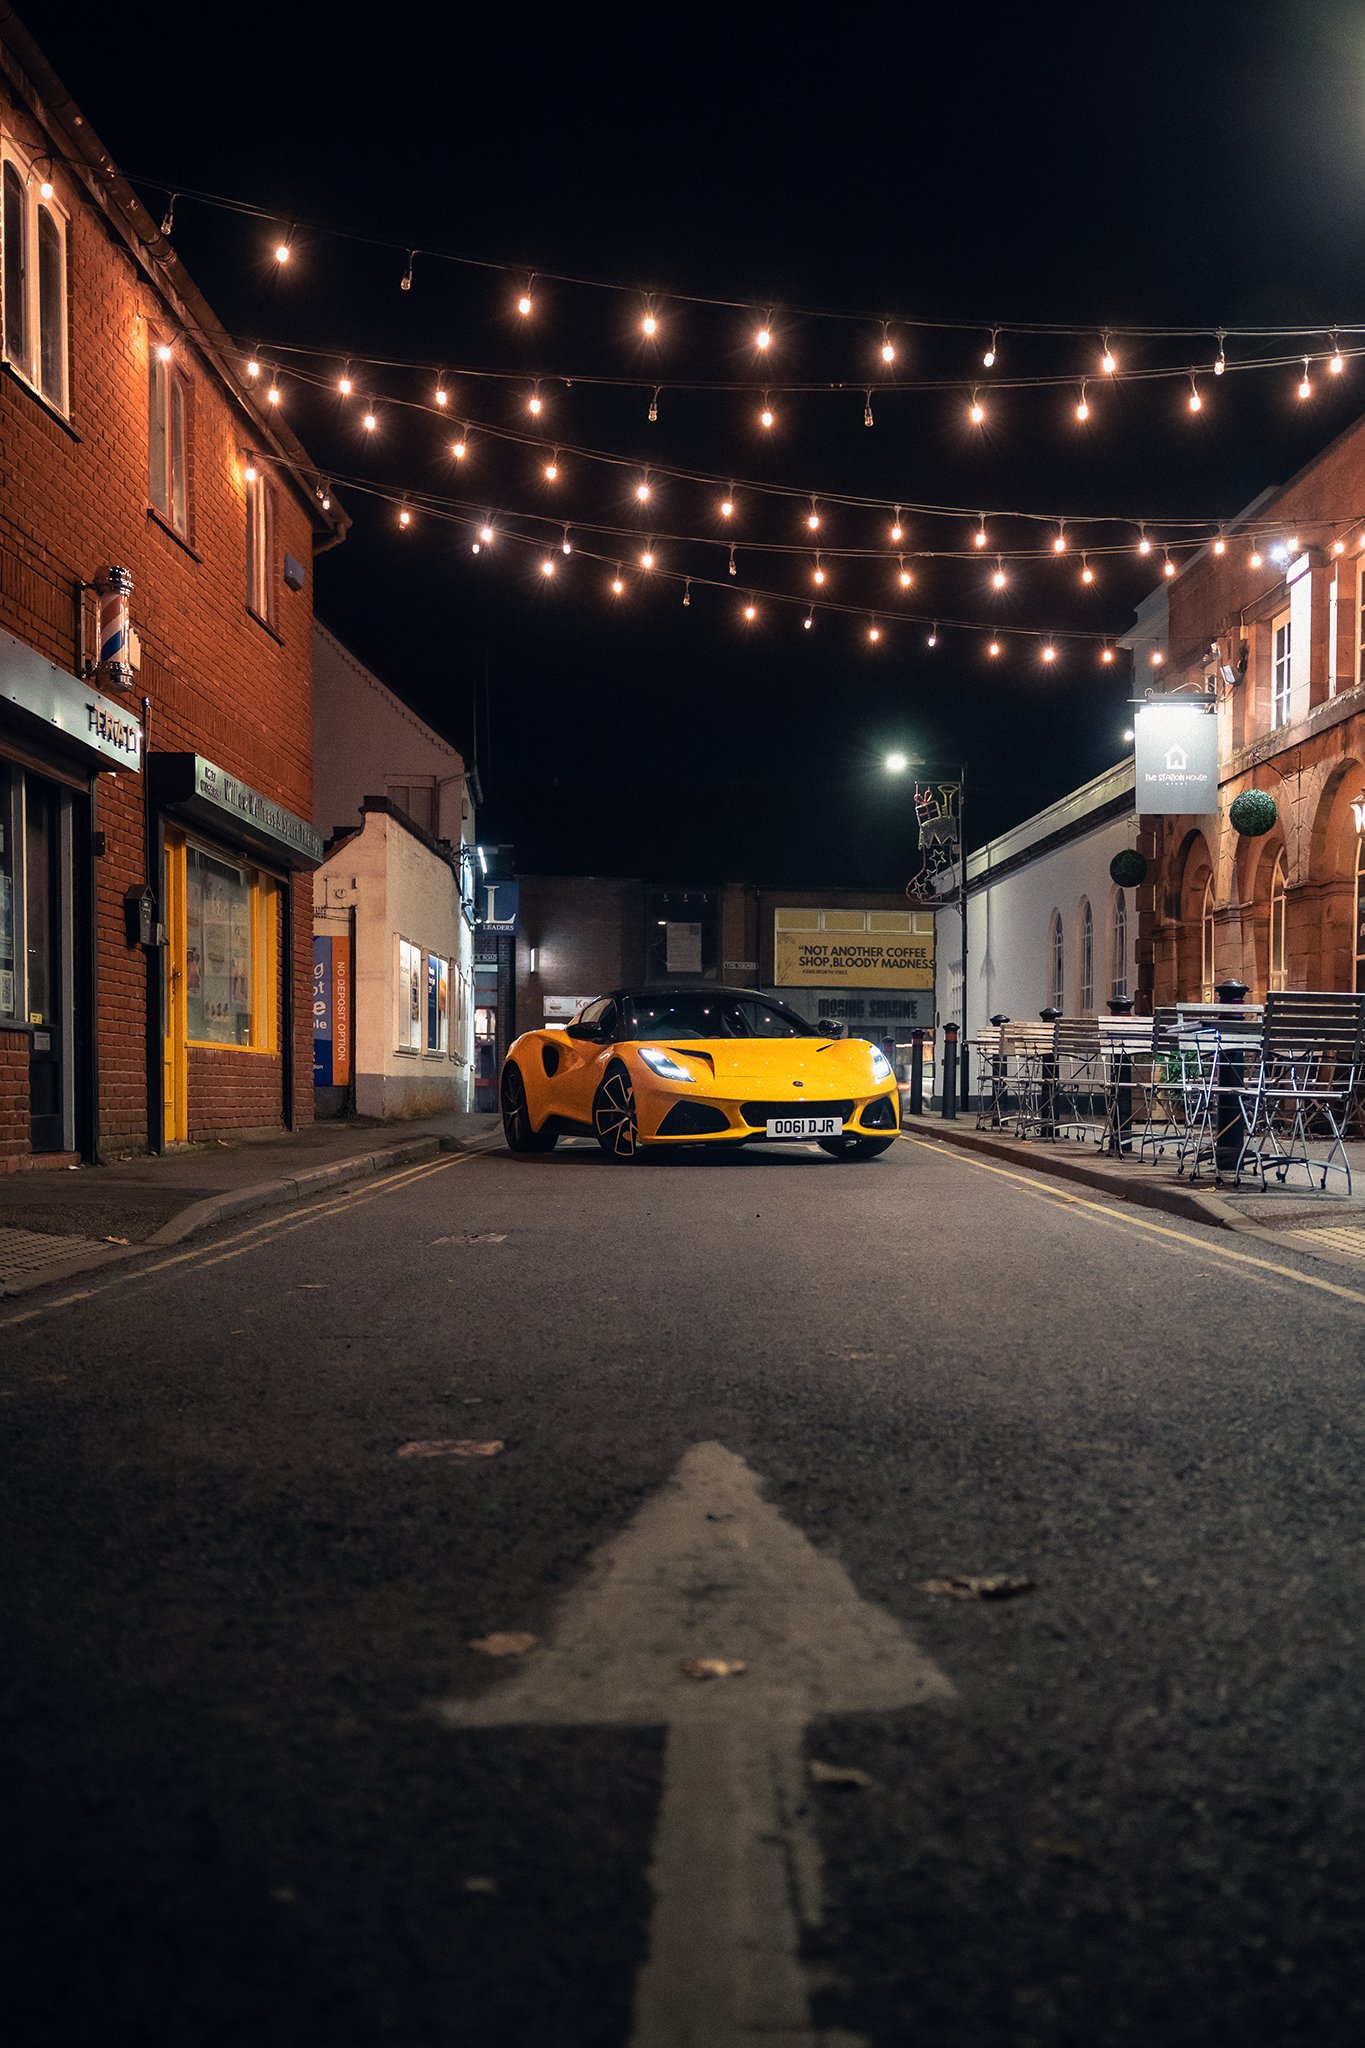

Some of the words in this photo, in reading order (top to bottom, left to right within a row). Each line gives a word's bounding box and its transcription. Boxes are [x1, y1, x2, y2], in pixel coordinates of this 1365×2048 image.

[830, 946, 884, 957] ANOTHER
[886, 947, 927, 958] COFFEE
[337, 961, 346, 976] NO
[337, 979, 346, 1021] DEPOSIT
[337, 1024, 346, 1061] OPTION
[808, 1119, 834, 1133] DJR
